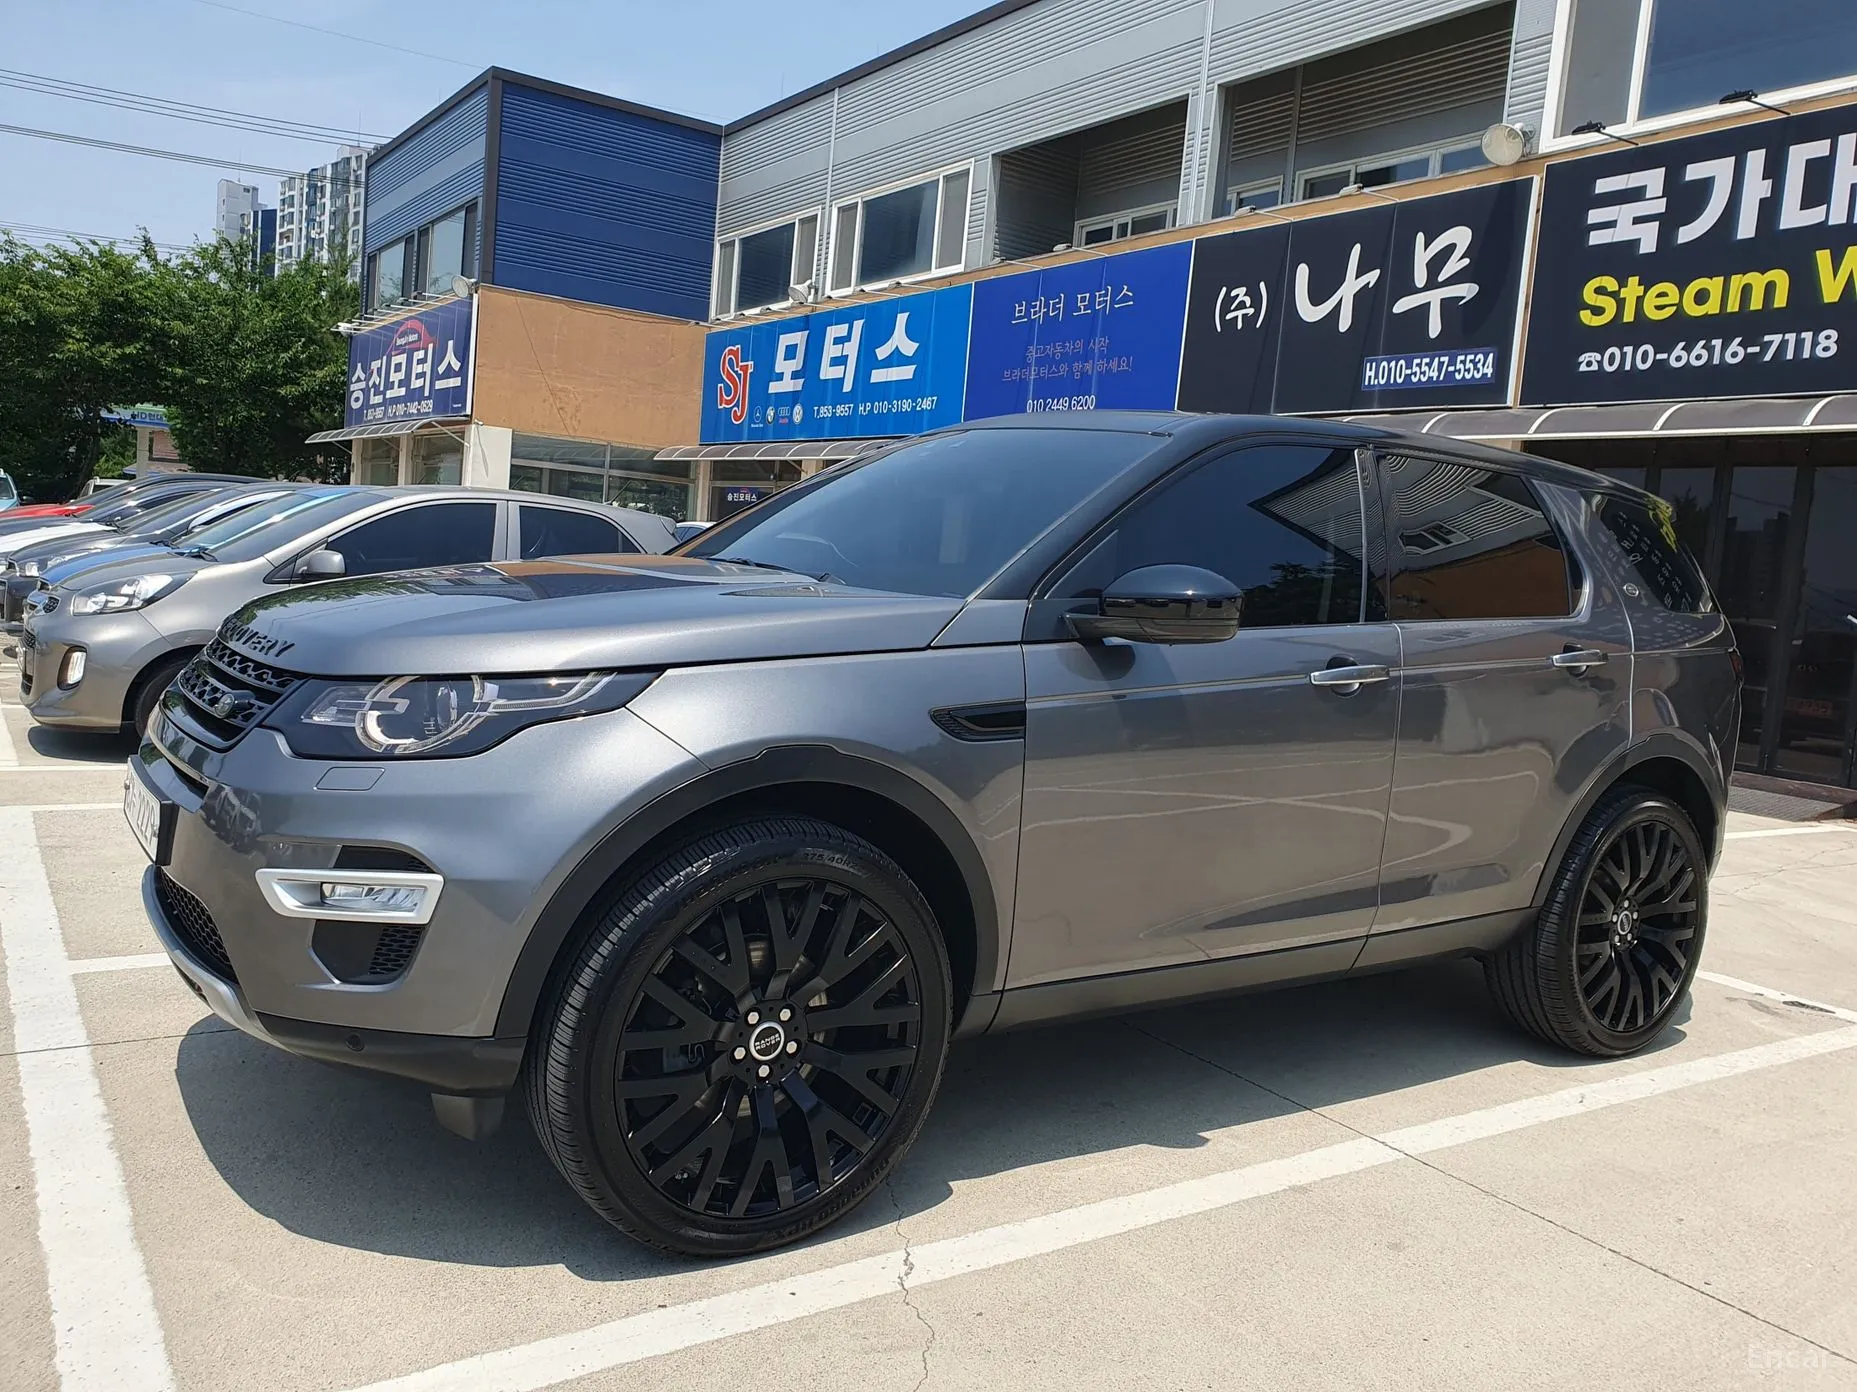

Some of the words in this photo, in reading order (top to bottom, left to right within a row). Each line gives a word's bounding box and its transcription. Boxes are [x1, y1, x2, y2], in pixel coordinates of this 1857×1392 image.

[1215, 281, 1267, 332] (주)
[1295, 226, 1479, 339] 나무
[1579, 268, 1790, 327] Steam
[1011, 293, 1064, 325] 브라더
[1073, 284, 1134, 315] 모터스
[768, 312, 920, 393] 모터스
[1025, 339, 1084, 364] 중고자동차의
[1088, 336, 1109, 354] 시작
[1603, 329, 1839, 373] 010-6616-7118
[350, 339, 461, 410] 승진모터스
[717, 344, 754, 424] SJ
[1002, 362, 1068, 382] 브라더모터스와
[1072, 359, 1093, 380] 함께
[1096, 356, 1133, 374] 하세요!
[1365, 353, 1494, 386] H.010-5547-5534
[814, 404, 854, 419] T.853-9557
[859, 403, 872, 416] H.P
[873, 396, 938, 414] 010-3190-2467
[1026, 399, 1044, 413] 010
[1045, 397, 1069, 412] 2449
[1071, 394, 1096, 411] 6200
[727, 492, 757, 502] 승진모터스
[754, 1032, 780, 1047] RANGE
[755, 1037, 781, 1051] ROVER
